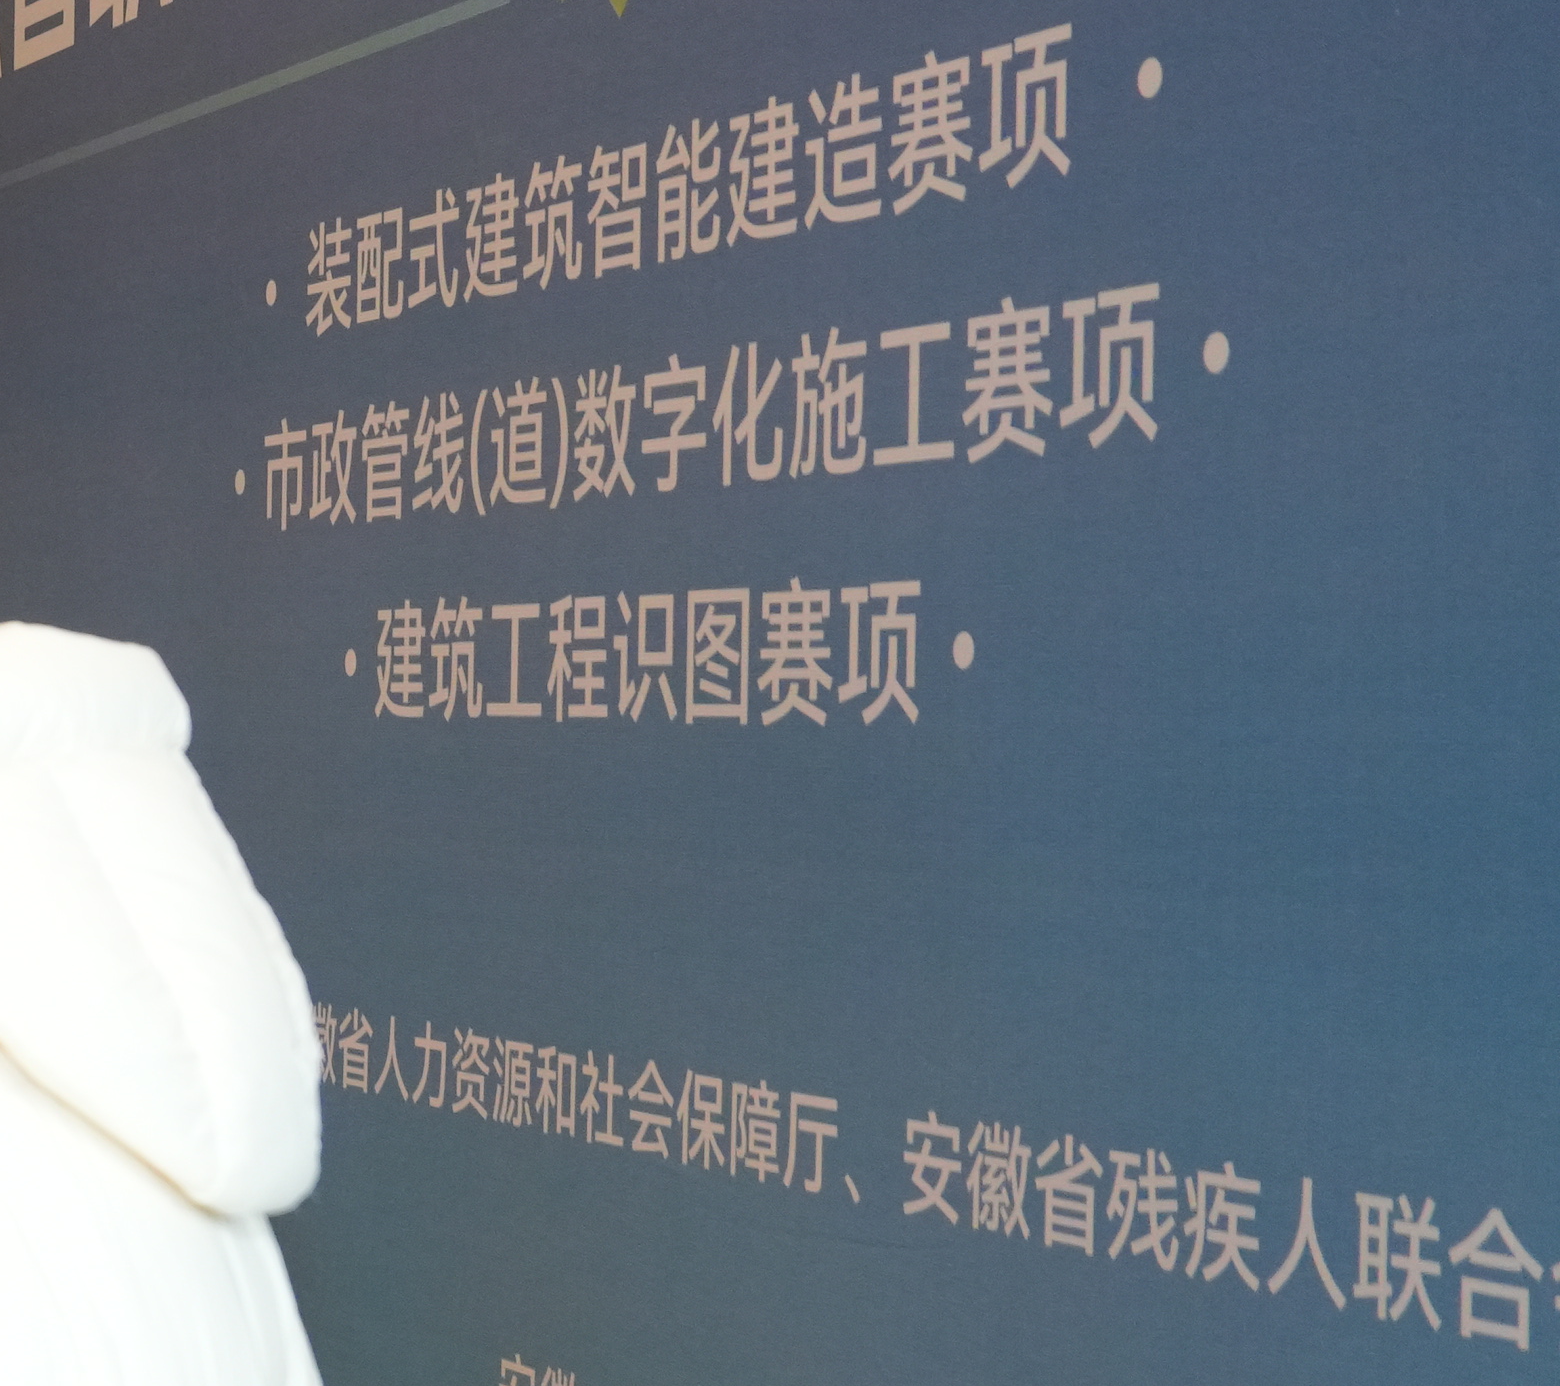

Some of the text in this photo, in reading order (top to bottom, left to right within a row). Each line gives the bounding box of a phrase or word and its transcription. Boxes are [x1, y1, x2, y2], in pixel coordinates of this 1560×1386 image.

[304, 21, 1073, 340] 装配式建筑智能建造赛项
[372, 577, 922, 728] 建筑工程识图赛项
